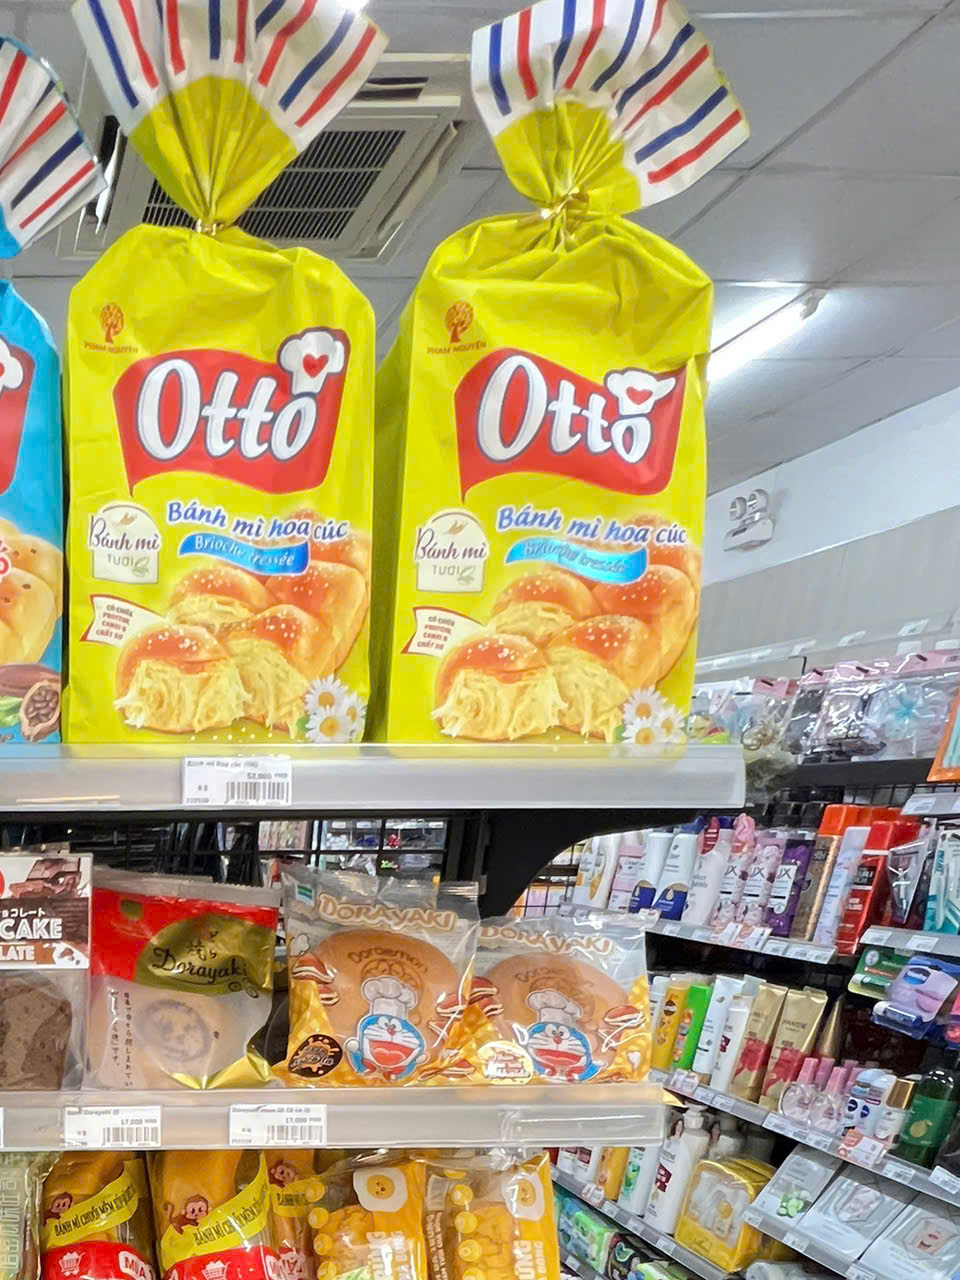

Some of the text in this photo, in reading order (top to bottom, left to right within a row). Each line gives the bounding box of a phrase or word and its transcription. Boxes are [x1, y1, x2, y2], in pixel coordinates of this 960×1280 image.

[138, 357, 318, 462] Otto
[477, 353, 652, 464] Otto
[168, 501, 348, 541] Bánh mì hoa cúc
[497, 506, 688, 545] Bánh mì hoa cúc
[151, 946, 249, 985] Dorayaki
